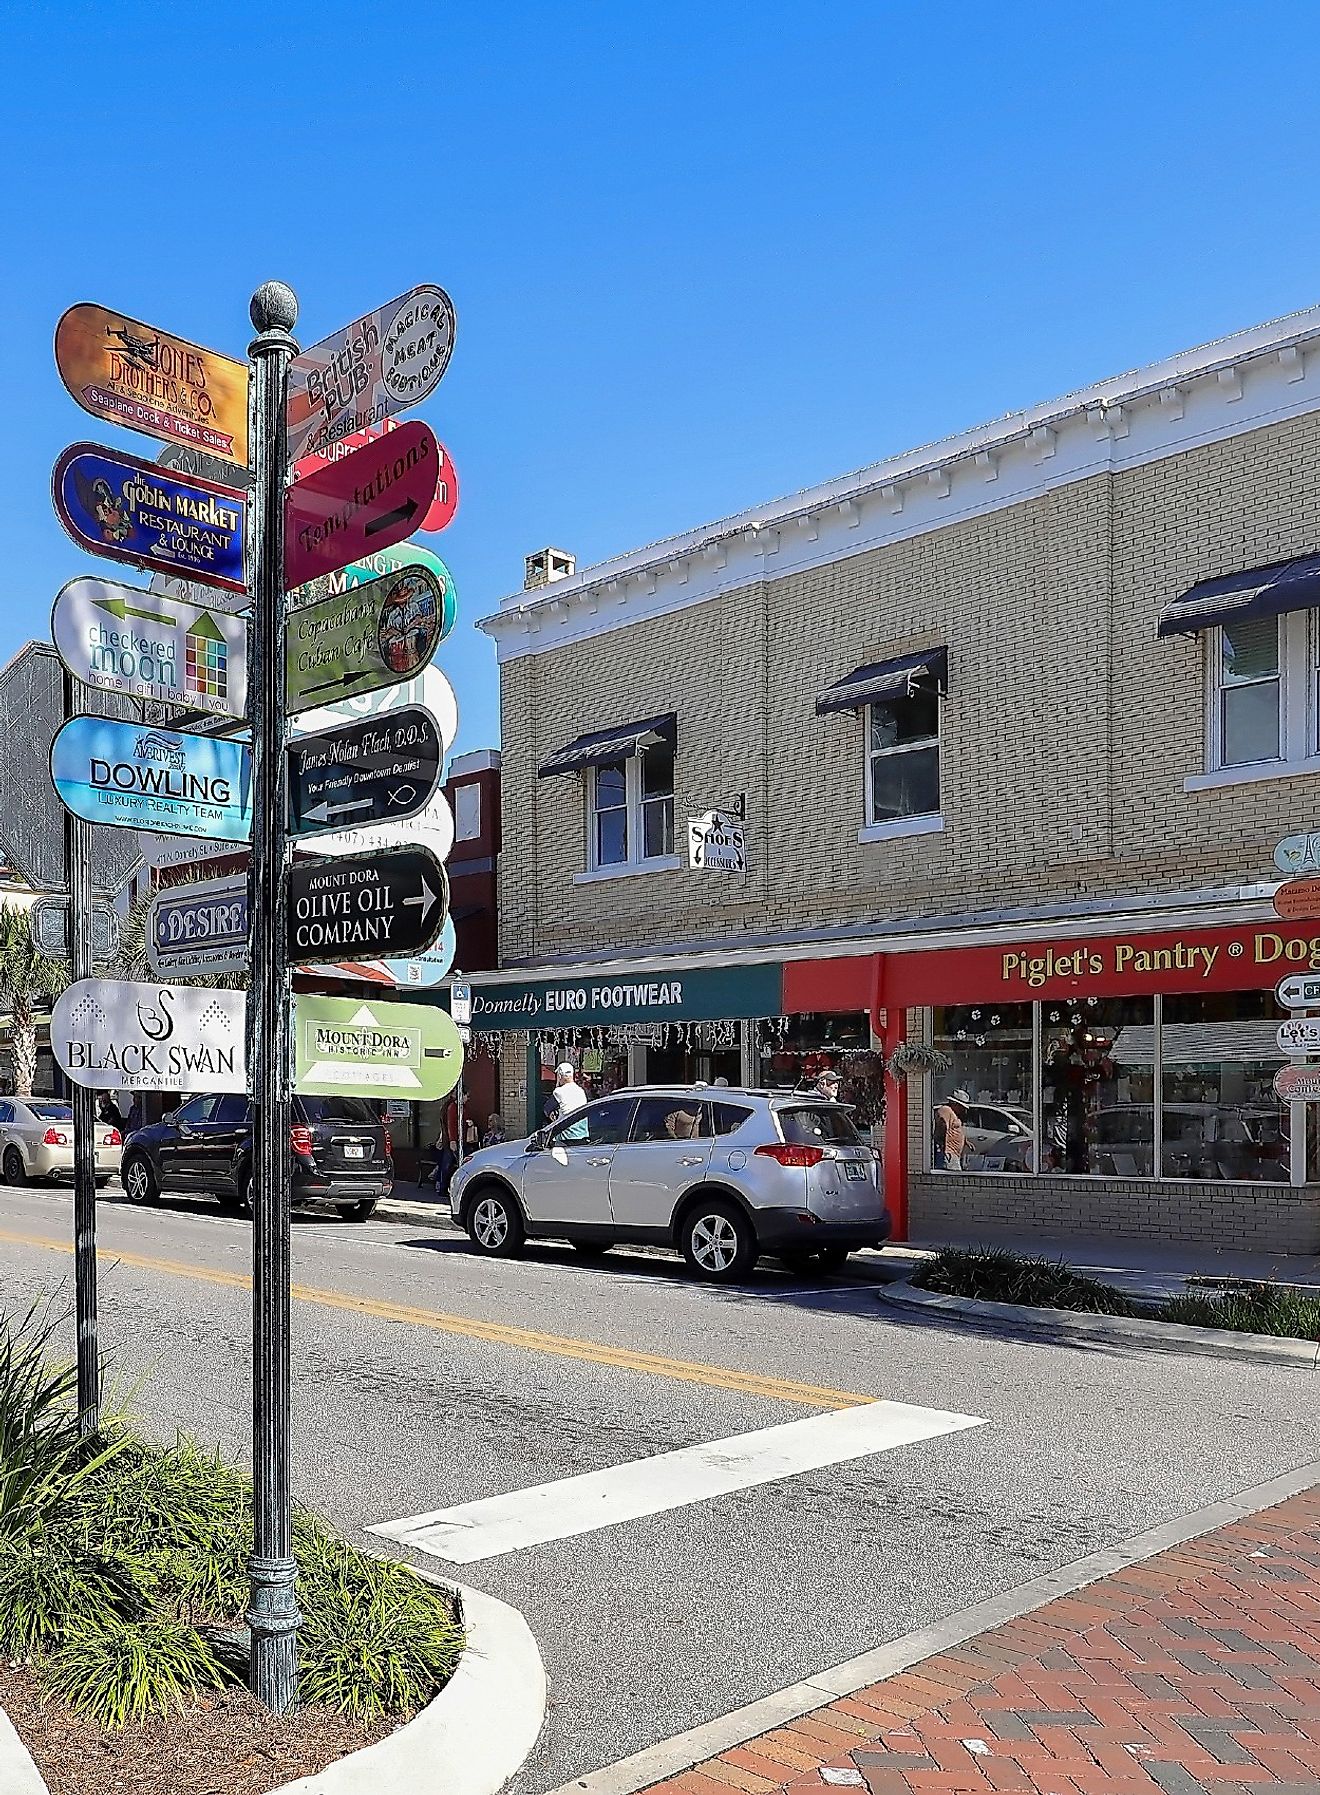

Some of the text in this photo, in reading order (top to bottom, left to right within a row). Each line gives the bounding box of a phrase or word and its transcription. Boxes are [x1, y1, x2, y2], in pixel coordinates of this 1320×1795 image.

[385, 303, 447, 354] MAGICAL
[150, 334, 206, 388] JONES
[307, 321, 379, 407] British
[394, 330, 438, 366] MEAT
[110, 352, 177, 405] BROTHERS
[91, 390, 228, 448] Seaplane Dock & Ticket Sales
[306, 432, 314, 451] &
[318, 397, 389, 445] Restaurant
[299, 436, 429, 552] Temptations
[139, 511, 231, 550] RESTAURANT
[159, 533, 214, 560] & LOUNGE
[298, 599, 376, 642] Copacabana
[89, 622, 176, 660] checkered
[298, 645, 341, 672] Cuban
[89, 644, 177, 688] moon
[88, 671, 229, 712] home gift baby you
[299, 749, 327, 776] James
[330, 740, 358, 766] Nolan
[394, 721, 429, 748] D.D.S.
[89, 758, 230, 803] DOWLING
[324, 775, 352, 792] Friendly
[353, 767, 391, 783] Downtown
[392, 759, 421, 774] Dentist
[99, 791, 223, 821] LUXURY REALTY TEAM
[692, 826, 743, 848] SHOES
[309, 868, 379, 891] MOUNT DORA
[167, 902, 243, 941] DESIRE
[296, 886, 394, 920] OLIVE OIL
[296, 916, 395, 947] COMPANY
[1001, 948, 1104, 987] Piglet's
[1115, 941, 1219, 977] Pantry
[471, 993, 542, 1016] Donnelly
[545, 988, 587, 1011] EURO
[591, 981, 683, 1009] FOOTWEAR
[317, 1028, 410, 1049] MOUNT DORA
[1281, 1024, 1318, 1039] Let's
[66, 1041, 235, 1076] BLACK SWAN
[328, 1046, 399, 1058] HISTORIC INN
[121, 1076, 183, 1087] MERCANTILE
